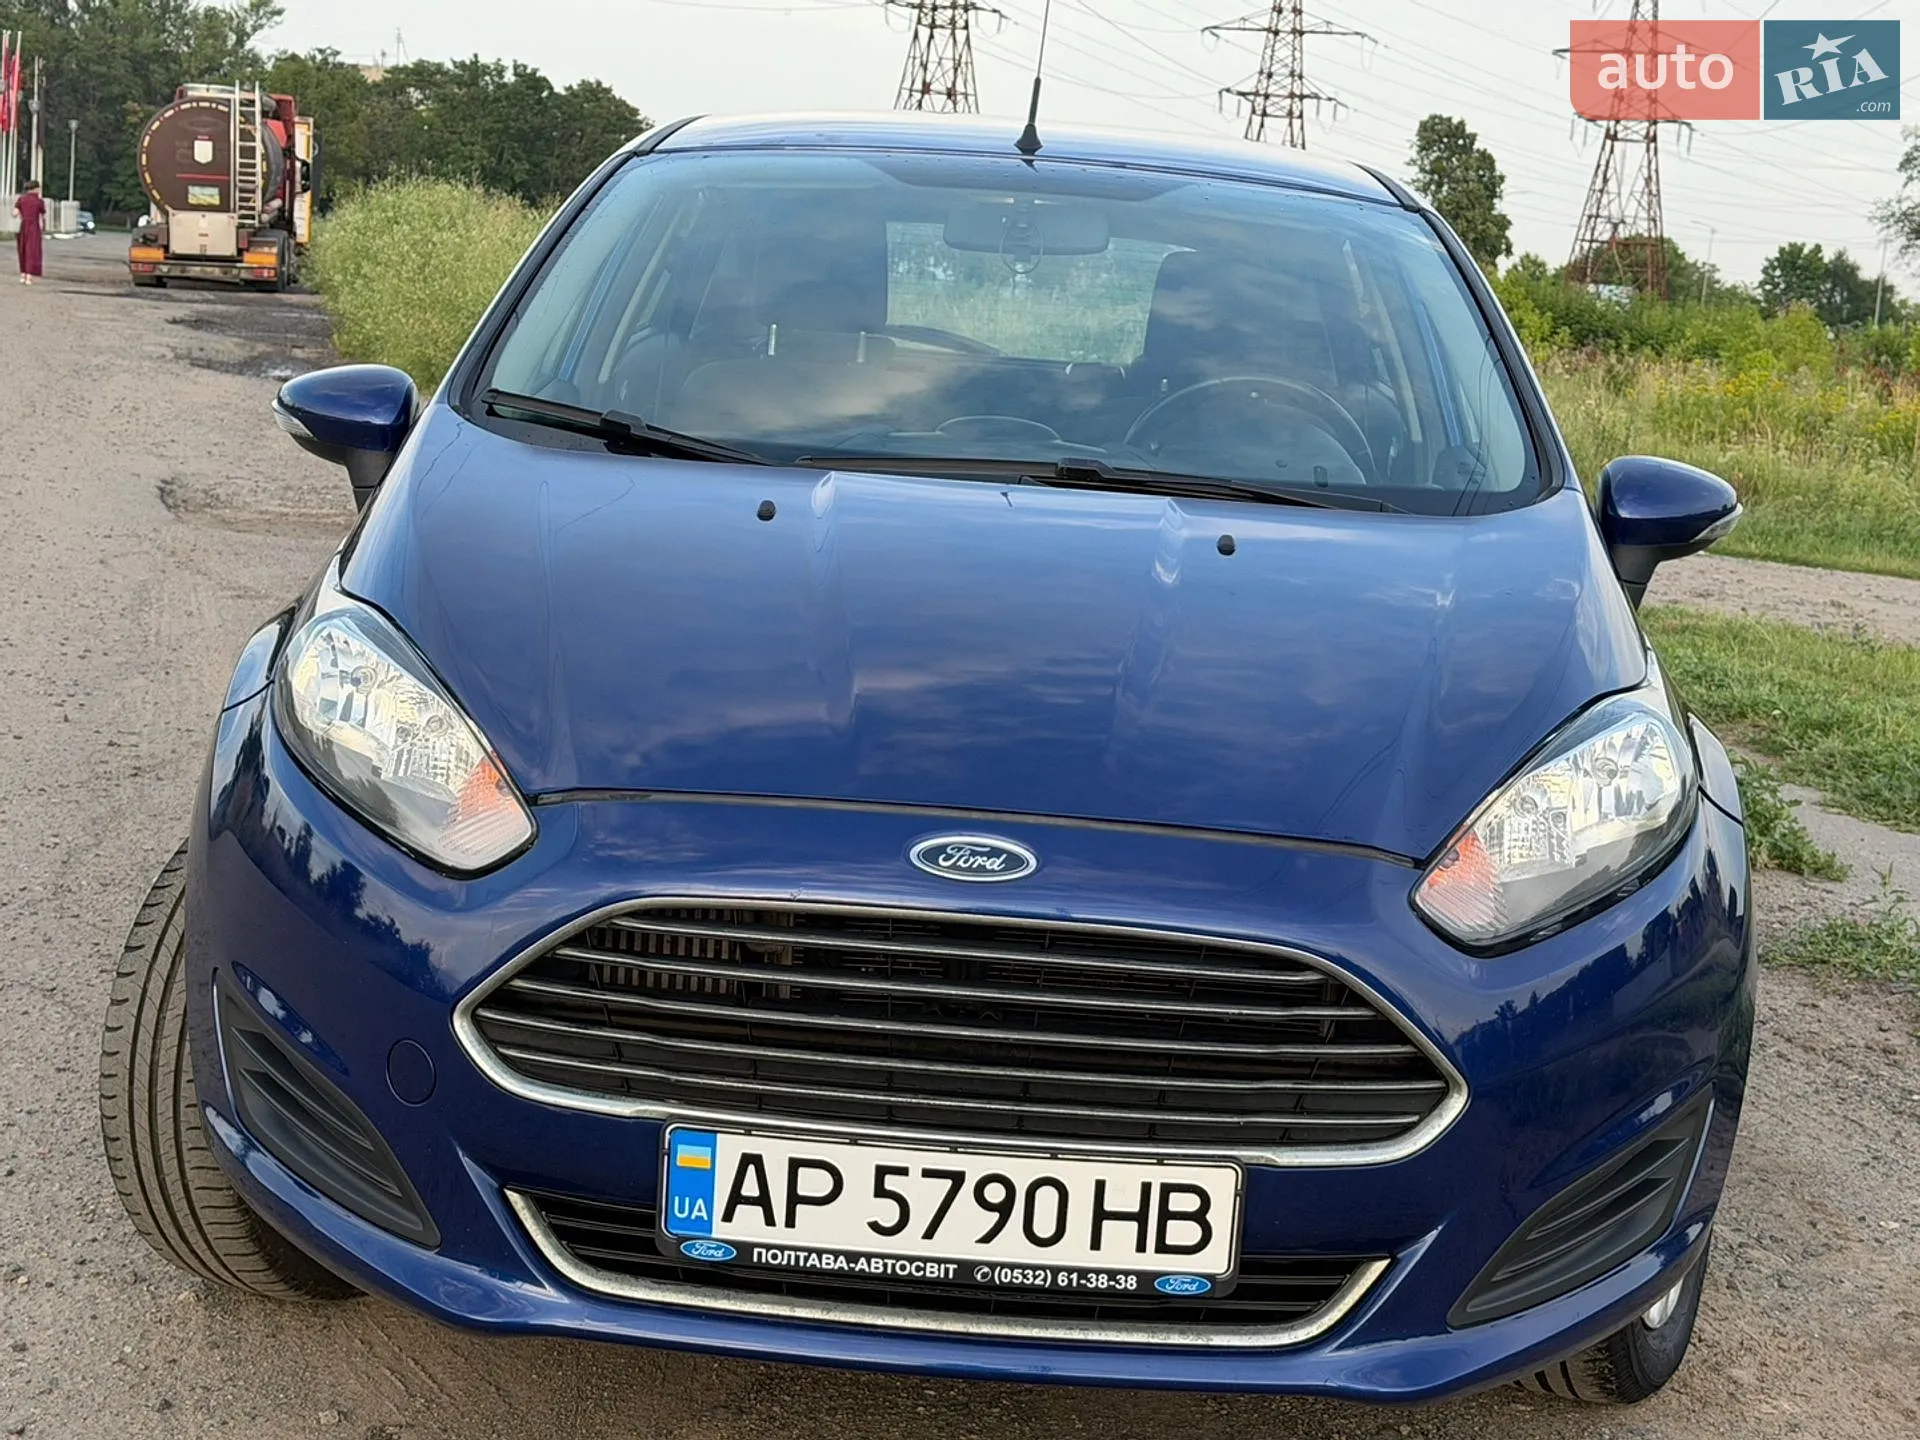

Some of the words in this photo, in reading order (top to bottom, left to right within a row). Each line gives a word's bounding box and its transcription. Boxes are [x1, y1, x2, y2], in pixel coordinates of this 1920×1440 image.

[938, 843, 1008, 871] Ford
[673, 1195, 708, 1221] UA
[720, 1152, 845, 1229] AP
[866, 1163, 1070, 1249] 5790
[1089, 1178, 1214, 1256] HB
[691, 1241, 726, 1259] Ford
[752, 1247, 959, 1279] ПОЛТАВА-АВТОСВІТ
[993, 1265, 1052, 1288] (0532)
[1056, 1271, 1138, 1291] 61-38-38
[1164, 1275, 1201, 1292] Ford
